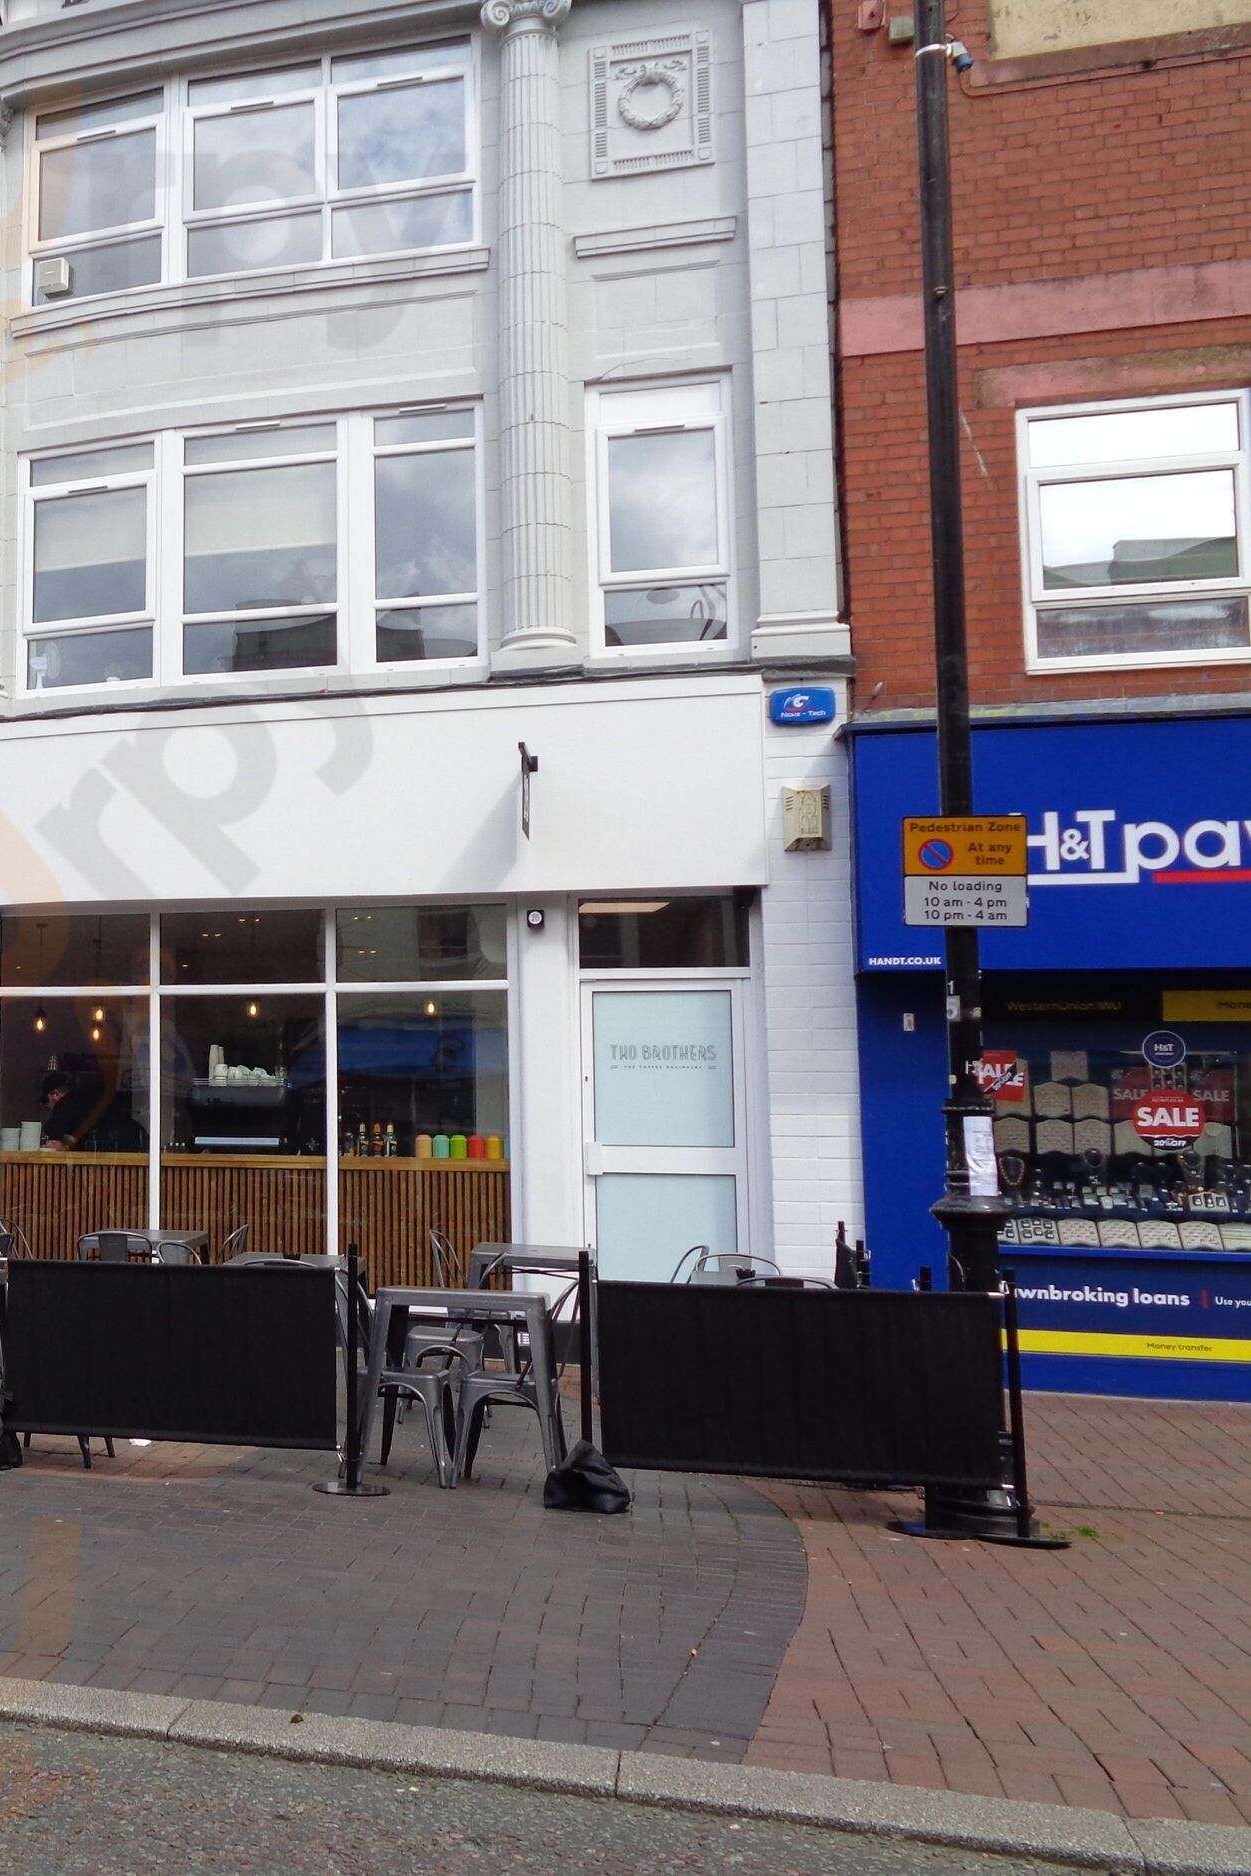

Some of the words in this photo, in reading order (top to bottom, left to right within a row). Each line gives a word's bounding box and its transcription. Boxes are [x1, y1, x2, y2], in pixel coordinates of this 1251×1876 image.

[910, 822, 983, 832] Pedestrian
[988, 821, 1021, 832] Zone
[967, 842, 983, 852] At
[988, 843, 1012, 854] any
[975, 856, 1005, 865] time
[929, 881, 948, 891] No
[953, 881, 1003, 893] loading
[924, 897, 940, 907] 10
[943, 899, 963, 907] am
[974, 897, 983, 907] 4
[987, 899, 1007, 909] pm
[924, 910, 940, 920] 10
[944, 911, 964, 921] pm
[975, 910, 984, 920] 4
[988, 911, 1007, 920] am
[869, 957, 942, 966] HANDT.CO.UK
[610, 1044, 637, 1060] TWO
[642, 1044, 717, 1061] BROTHERS
[1192, 1089, 1229, 1101] SALE
[1137, 1106, 1199, 1127] SALE
[1014, 1284, 1129, 1308] wnbroking
[1133, 1287, 1190, 1306] loans
[1215, 1296, 1234, 1306] Use
[1147, 1342, 1176, 1351] Money
[1177, 1343, 1213, 1352] transfer
